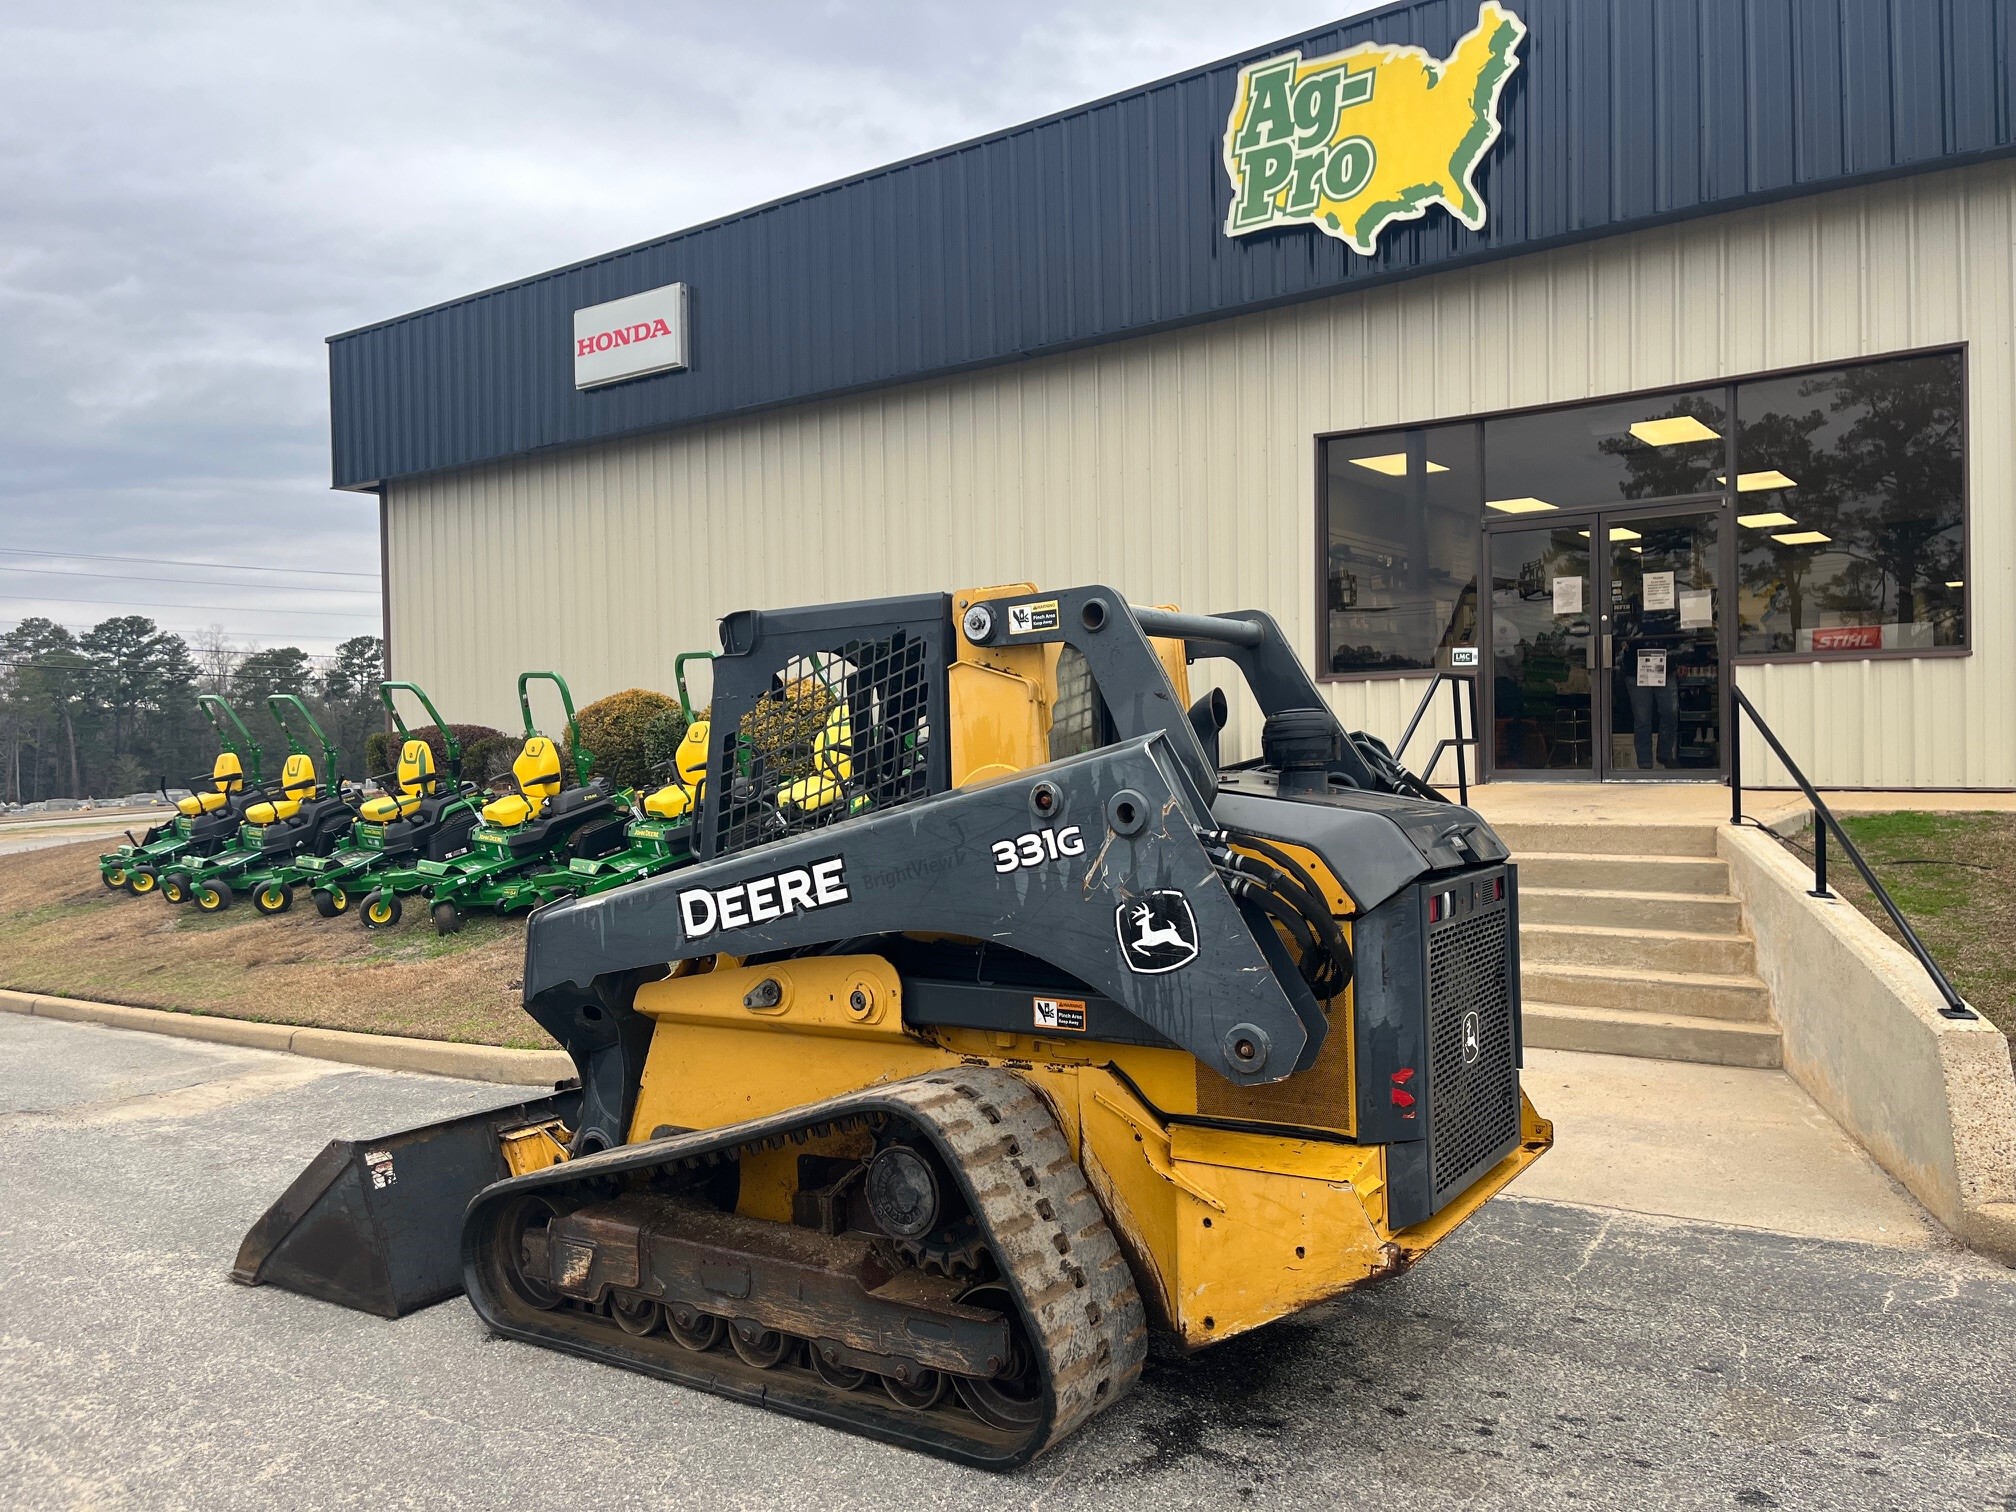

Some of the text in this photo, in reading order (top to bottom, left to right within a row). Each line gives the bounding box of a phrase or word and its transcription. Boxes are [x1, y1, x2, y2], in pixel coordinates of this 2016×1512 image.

[1235, 62, 1375, 154] Ag-
[1235, 138, 1376, 226] Pro
[577, 318, 672, 357] HONDA
[1818, 635, 1873, 648] STIHL
[863, 853, 953, 890] BrightView
[991, 826, 1086, 873] 331G
[678, 857, 850, 940] DEERE
